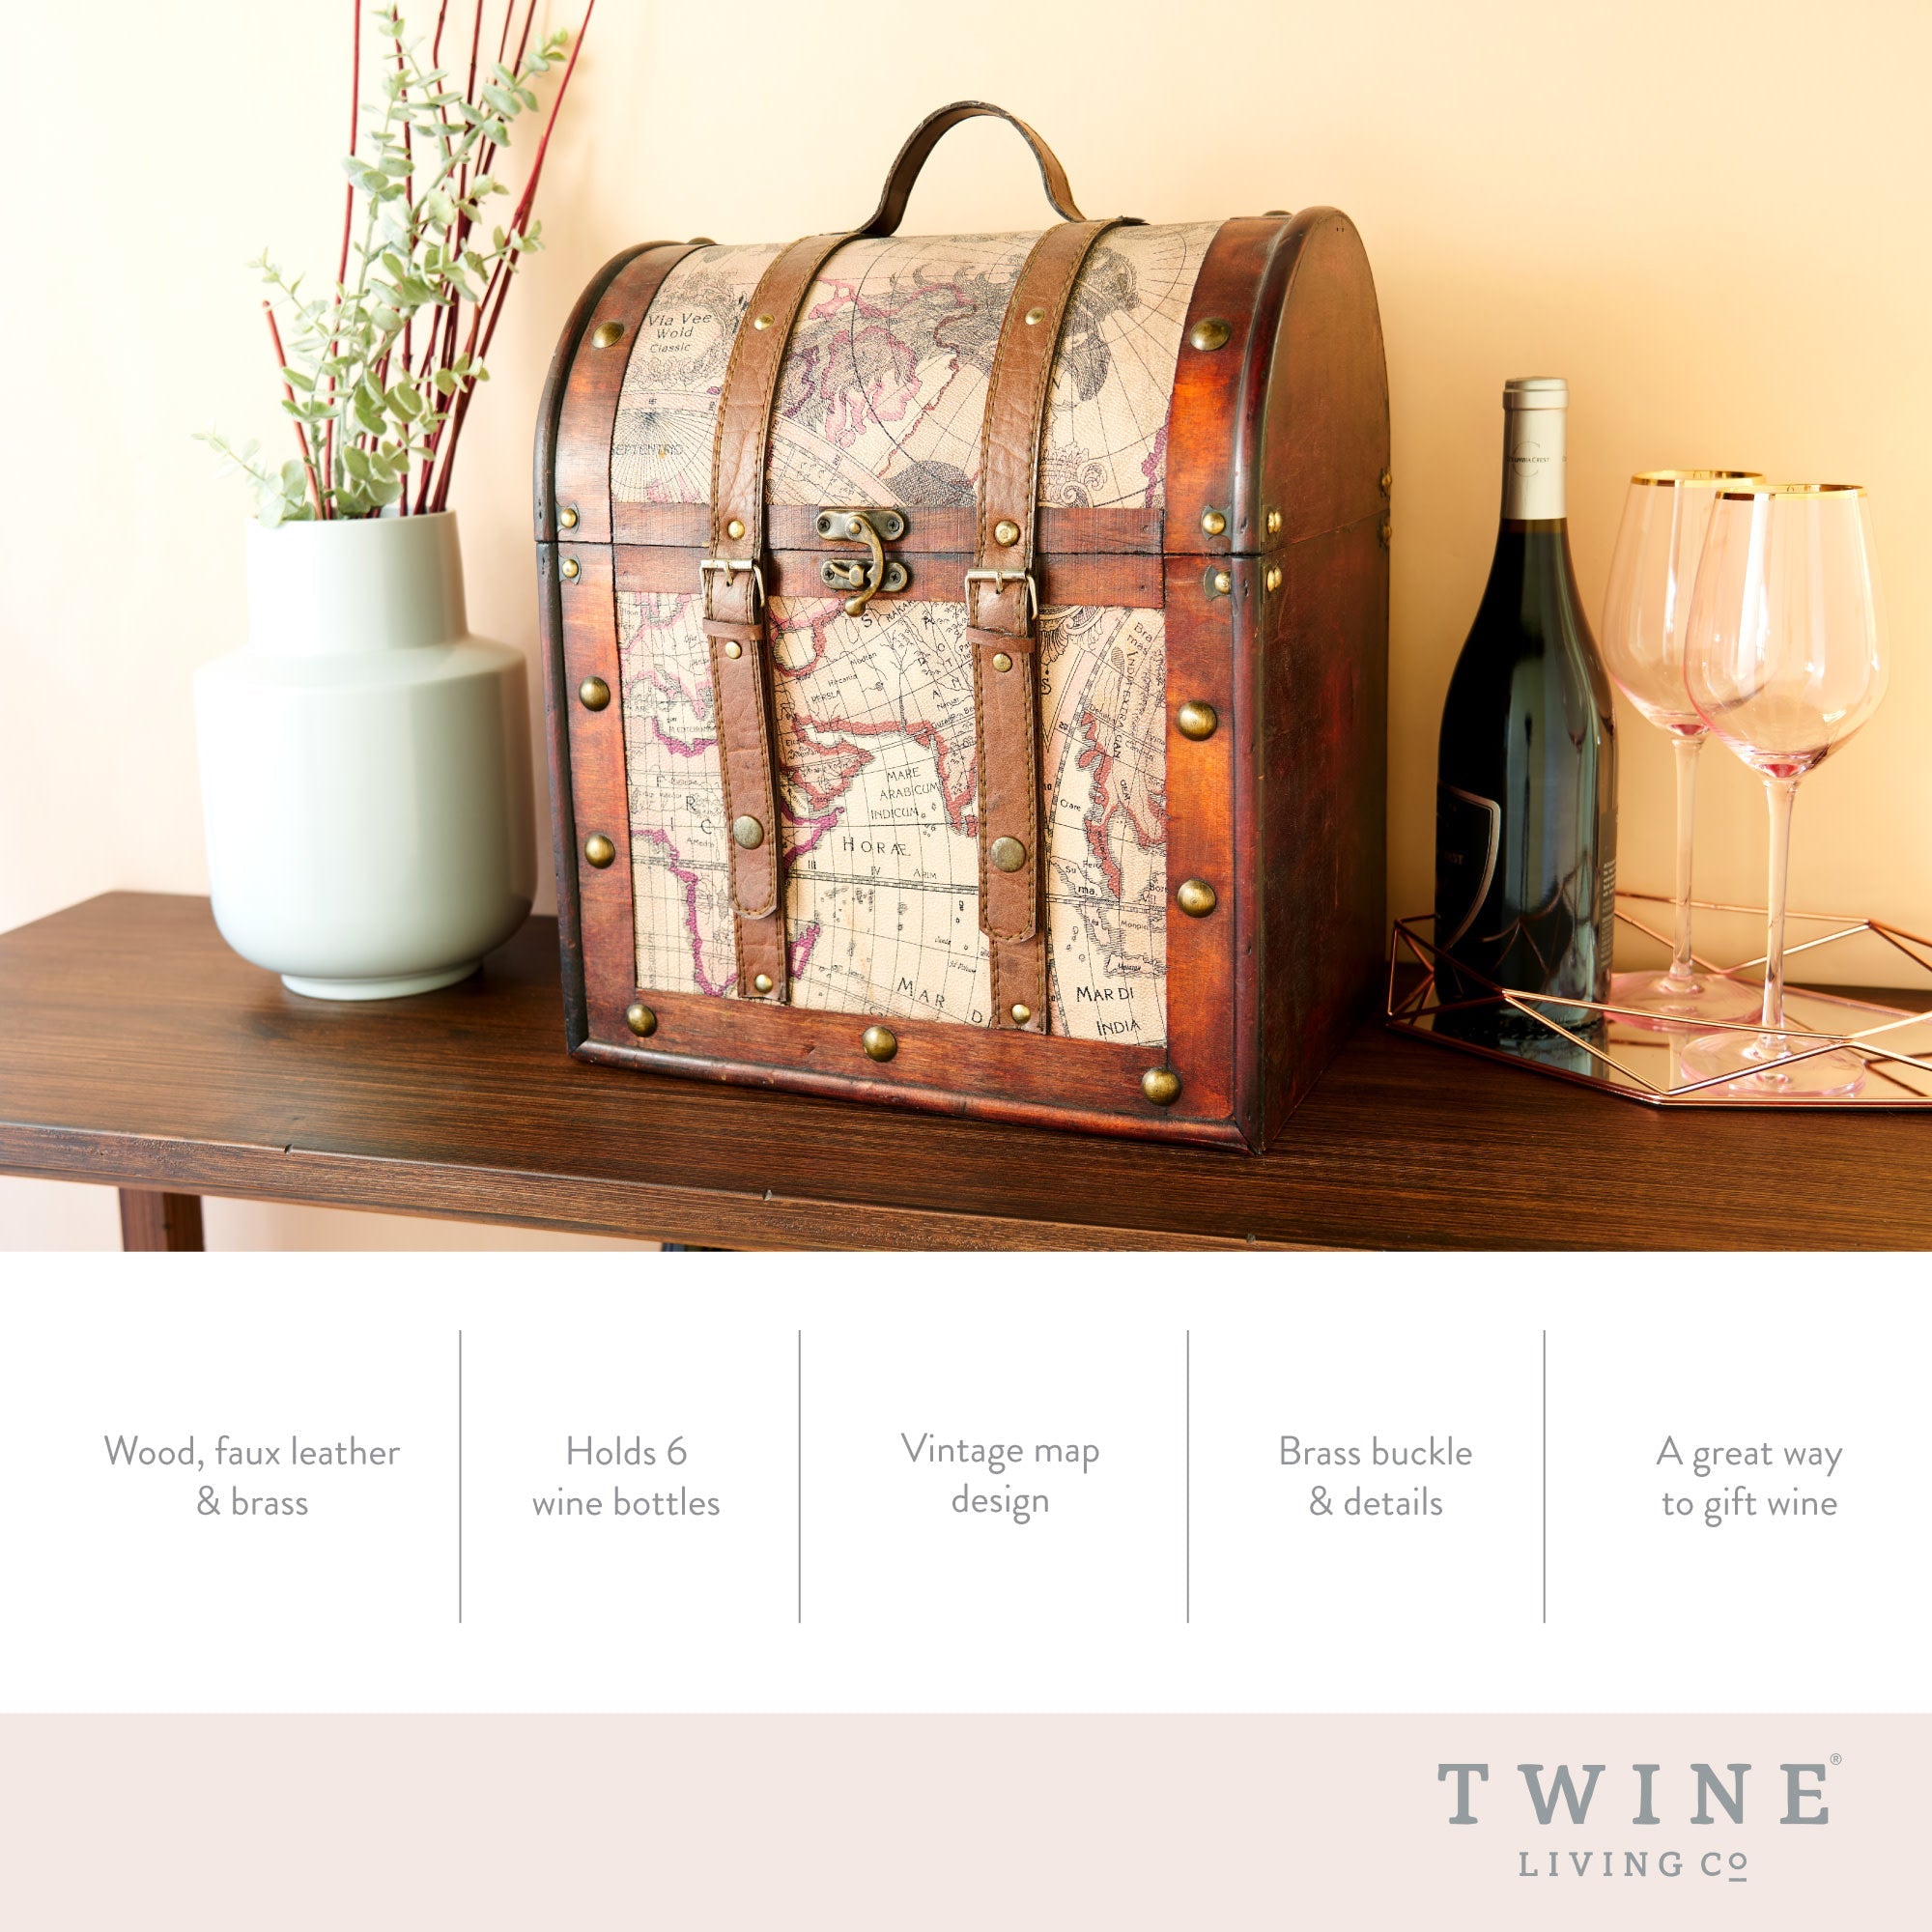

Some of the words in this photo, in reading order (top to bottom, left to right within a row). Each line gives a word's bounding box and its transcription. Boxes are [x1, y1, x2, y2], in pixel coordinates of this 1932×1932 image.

[649, 314, 674, 327] Via
[682, 313, 712, 325] Vee
[886, 766, 921, 781] MARE
[879, 782, 940, 801] ARABICUM
[869, 807, 919, 820] INDICUM
[1096, 1019, 1141, 1037] INDIA
